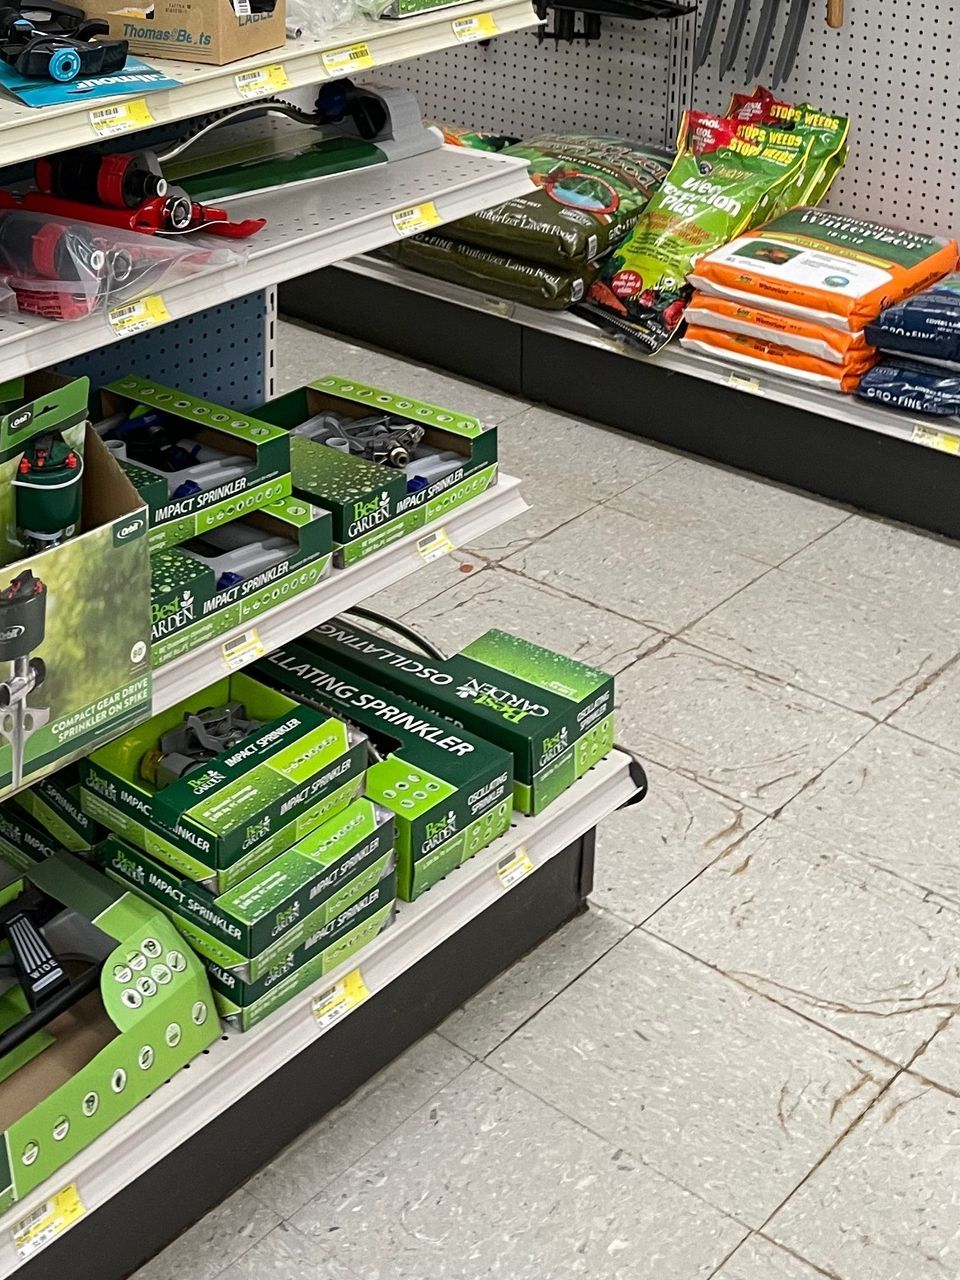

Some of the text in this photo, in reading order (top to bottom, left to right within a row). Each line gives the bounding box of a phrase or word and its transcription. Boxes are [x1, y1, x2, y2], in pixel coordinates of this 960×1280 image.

[770, 104, 840, 131] STOPS WEEDS
[736, 124, 804, 147] STOPS WEEDS
[505, 257, 533, 275] Lawn
[14, 414, 28, 427] Orbit
[155, 477, 247, 523] IMPACT SPRINKLER
[396, 468, 464, 514] IMPACT SPRINKLER
[347, 505, 390, 538] GARDEN
[353, 497, 380, 521] Best
[121, 523, 139, 536] Orbit
[202, 560, 289, 615] IMPACT SPRINKLER
[0, 628, 19, 641] Orbit
[151, 606, 194, 641] ARDEN
[314, 622, 454, 686] OSCILLATING
[51, 677, 149, 735] COMPACT GEAR DRIVE
[466, 677, 550, 718] GARDEN
[58, 688, 149, 743] SPRINKLER ON SPIKE
[351, 693, 475, 758] SPRINKLER
[224, 718, 302, 767] IMPACT SPRINKLER
[539, 737, 569, 768] GARDEN
[192, 775, 226, 796] GARDEN
[279, 758, 352, 816] IMPACT SPRINKLER
[467, 771, 508, 807] OSCILLATING
[470, 785, 506, 816] SPRINKLER
[421, 824, 458, 854] GARDEN
[424, 815, 448, 840] Best
[309, 836, 380, 901] IMPACT SPRINKLER
[148, 872, 242, 941] IMPACT SPRINKLER
[304, 888, 380, 951] IMPACT SPRINKLER
[29, 958, 59, 980] WIDE
